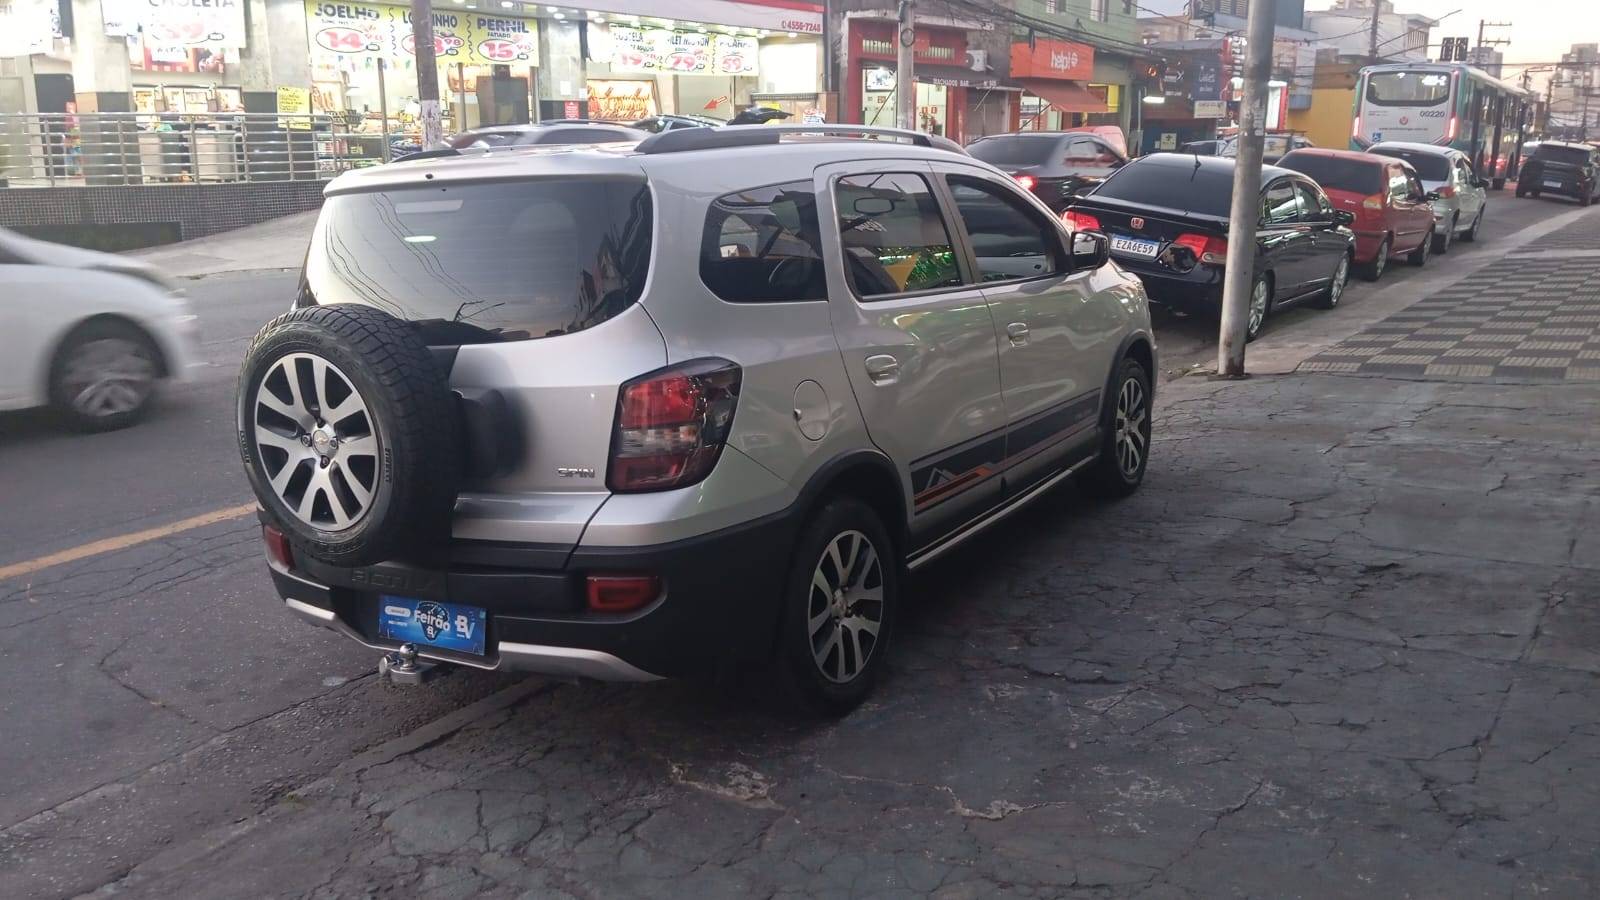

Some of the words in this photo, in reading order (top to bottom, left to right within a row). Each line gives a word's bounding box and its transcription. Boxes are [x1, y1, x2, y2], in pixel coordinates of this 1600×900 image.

[314, 3, 380, 20] JOELHO
[402, 11, 458, 28] LOINHO
[477, 17, 529, 34] PERNIL
[324, 30, 364, 49] 14
[484, 42, 513, 59] 15
[1419, 110, 1445, 118] 00220
[1116, 239, 1154, 254] EZA6E59
[557, 467, 595, 478] SPIN
[414, 609, 451, 632] Feirão
